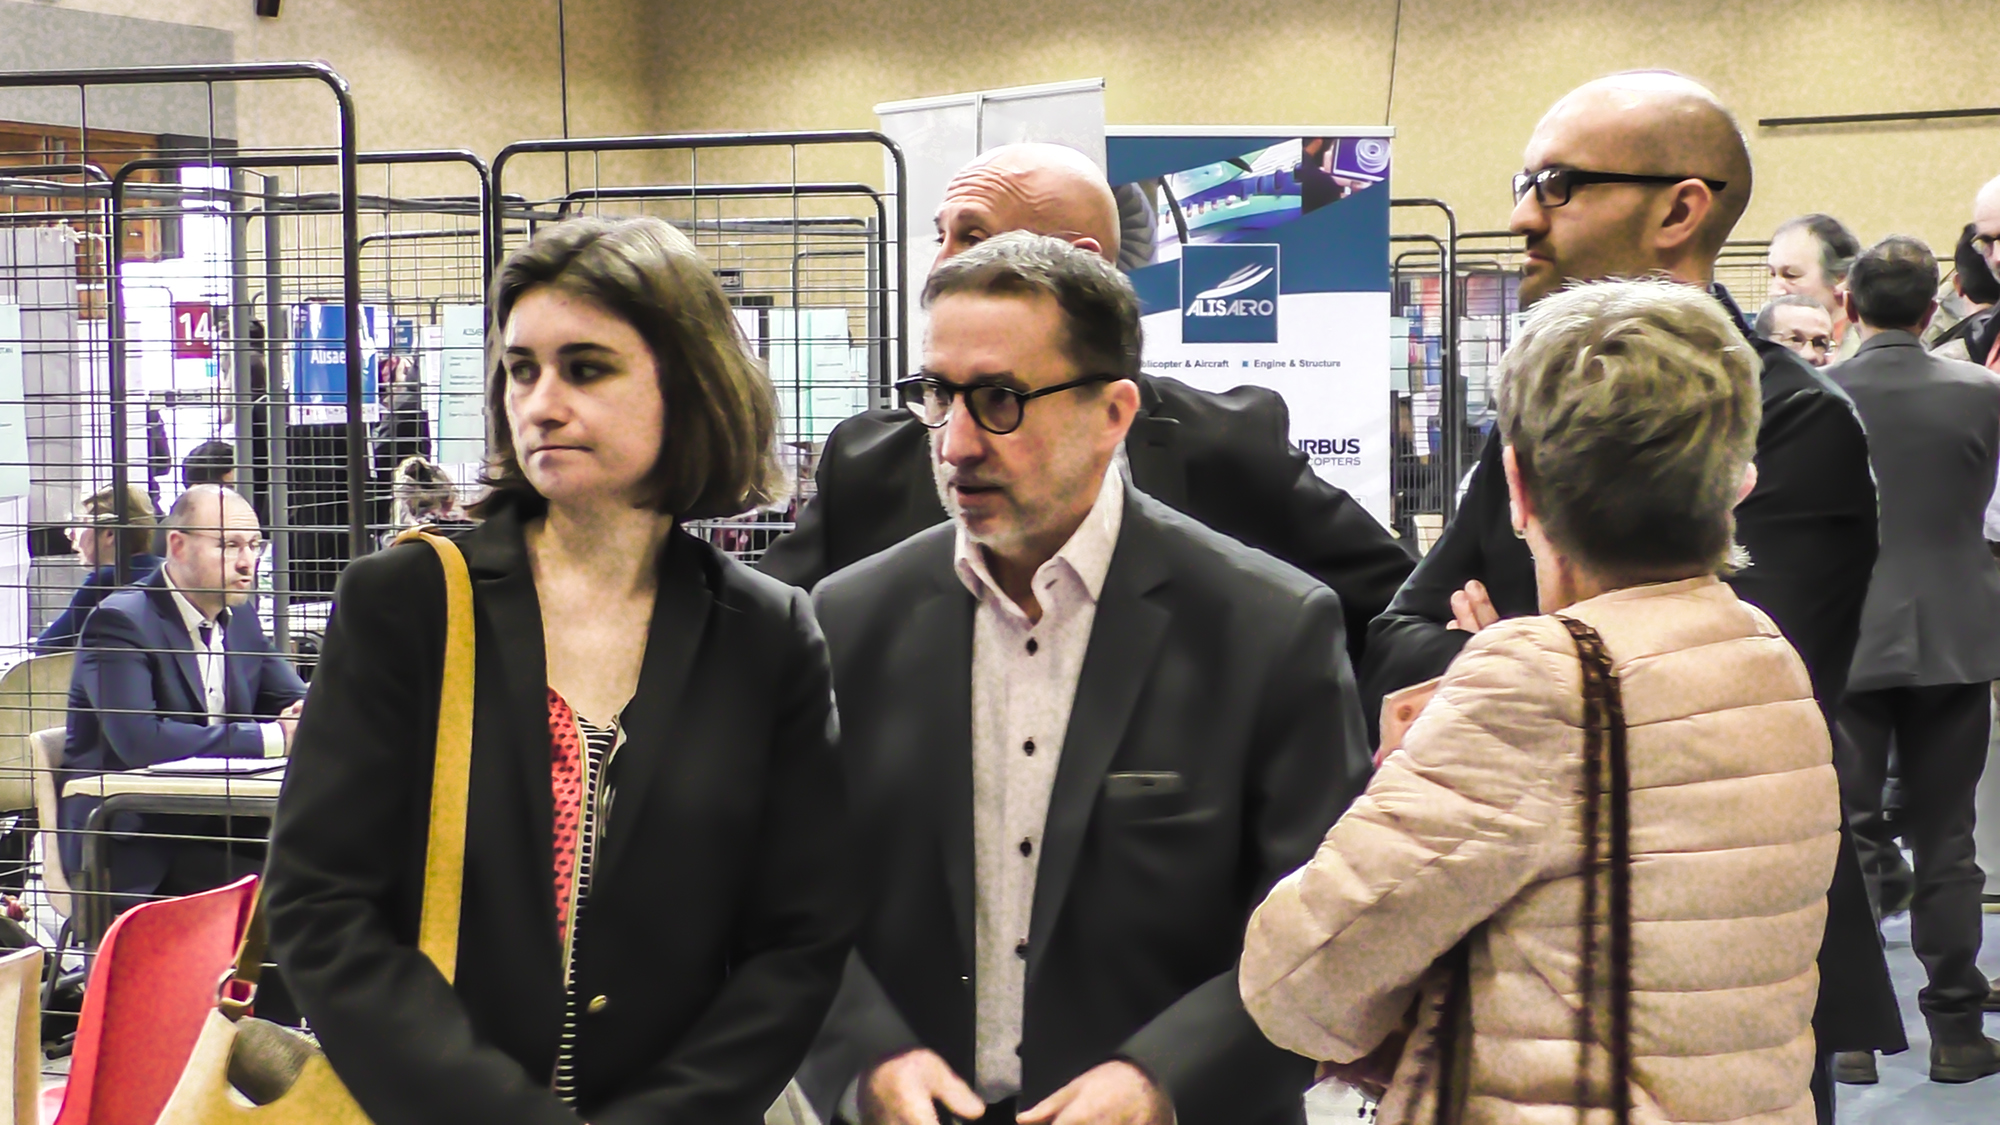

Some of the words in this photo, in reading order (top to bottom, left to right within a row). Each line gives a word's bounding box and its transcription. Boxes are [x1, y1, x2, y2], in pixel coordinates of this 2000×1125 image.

[1185, 299, 1274, 316] ALISAERO
[179, 312, 210, 346] 14
[310, 349, 346, 365] Alisae
[1185, 359, 1192, 368] &
[1194, 359, 1229, 368] Aircraft
[1254, 359, 1286, 370] Engine
[1289, 359, 1296, 368] &
[1299, 359, 1341, 368] Structure
[1298, 438, 1361, 455] IRBUS
